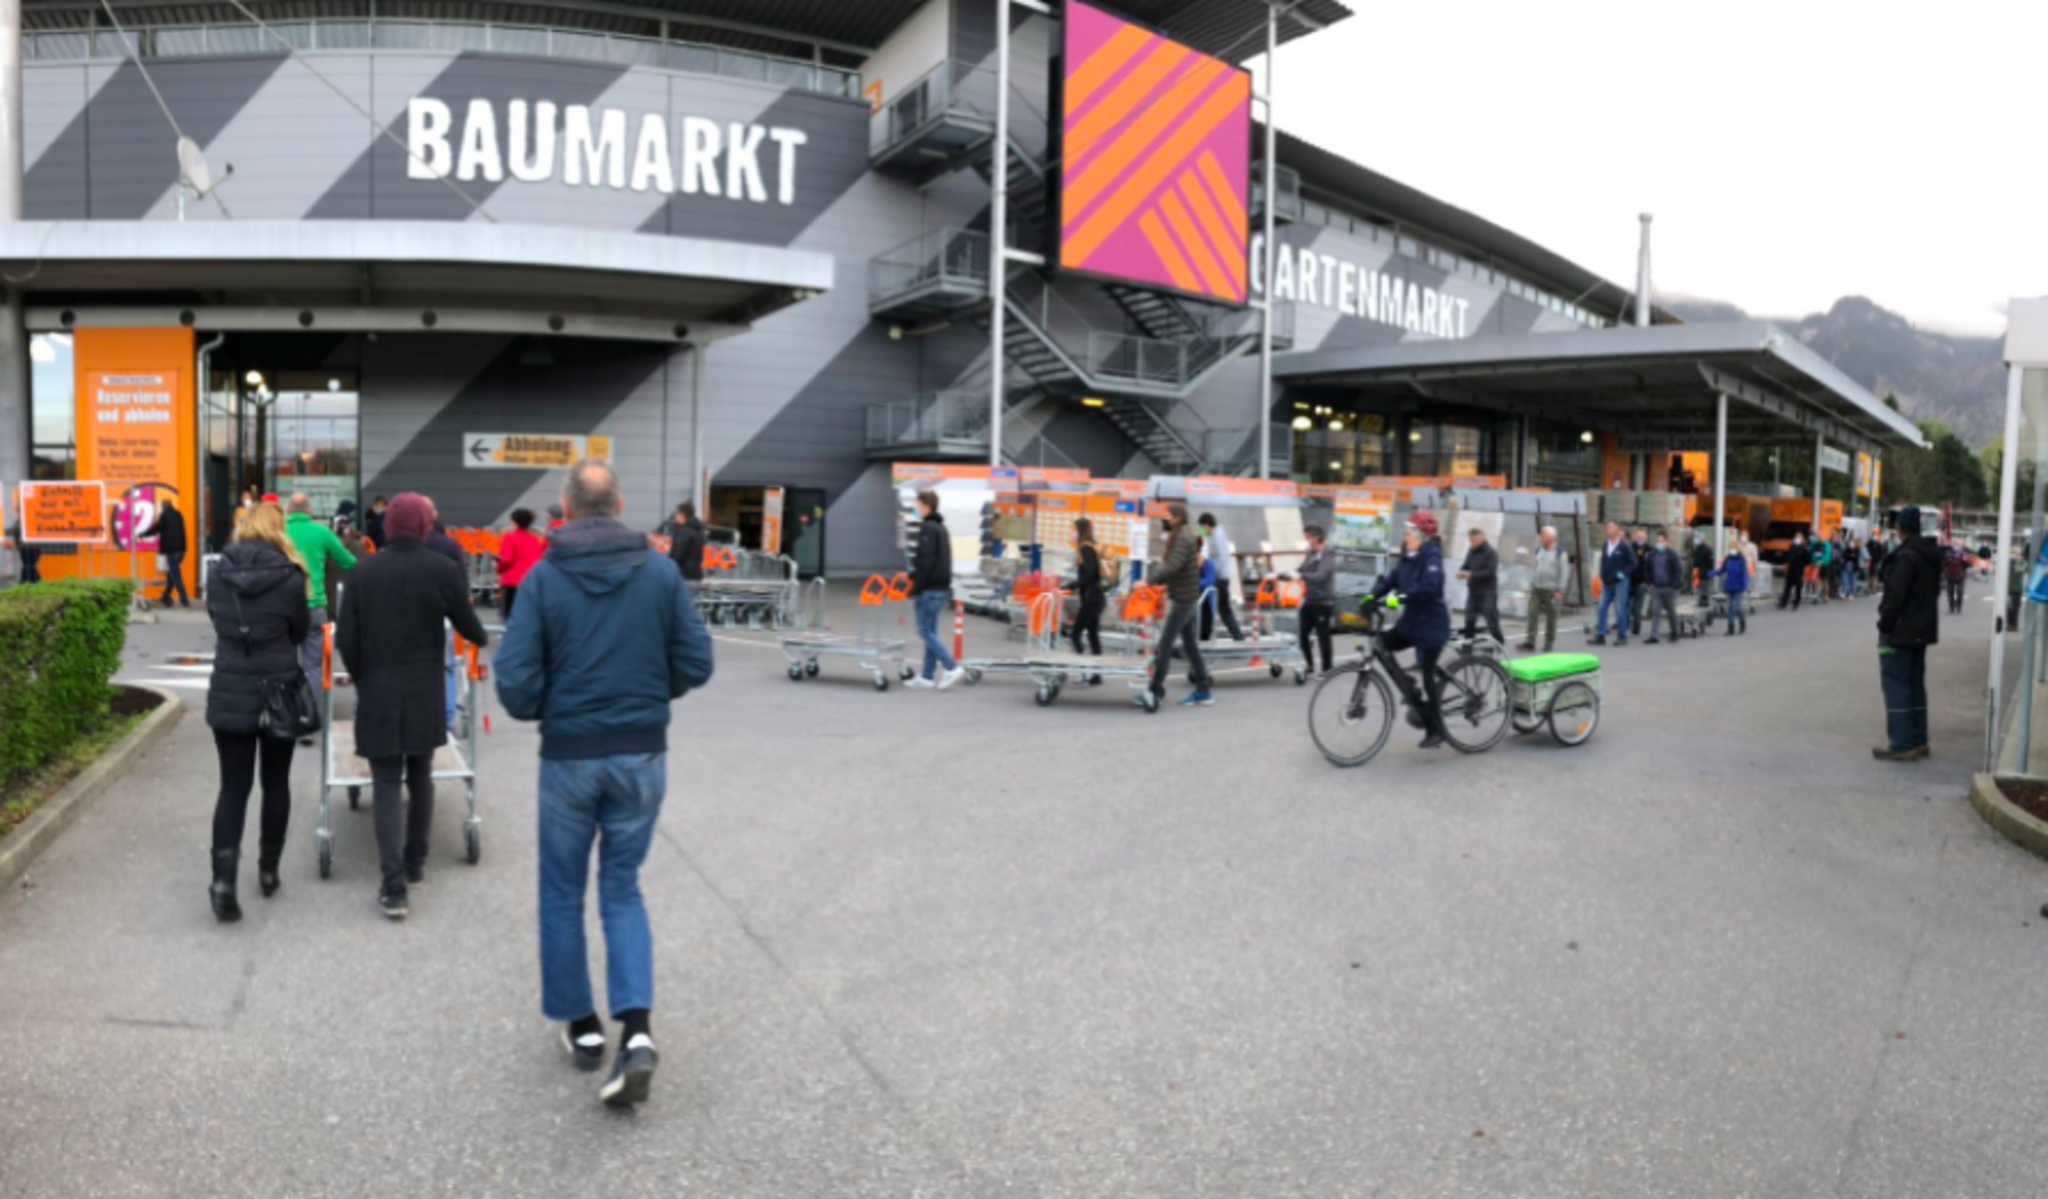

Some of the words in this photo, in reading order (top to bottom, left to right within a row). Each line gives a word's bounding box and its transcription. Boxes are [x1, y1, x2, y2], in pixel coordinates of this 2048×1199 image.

[407, 97, 807, 205] BAUMARKT
[97, 408, 119, 422] und
[503, 435, 572, 457] Abholung
